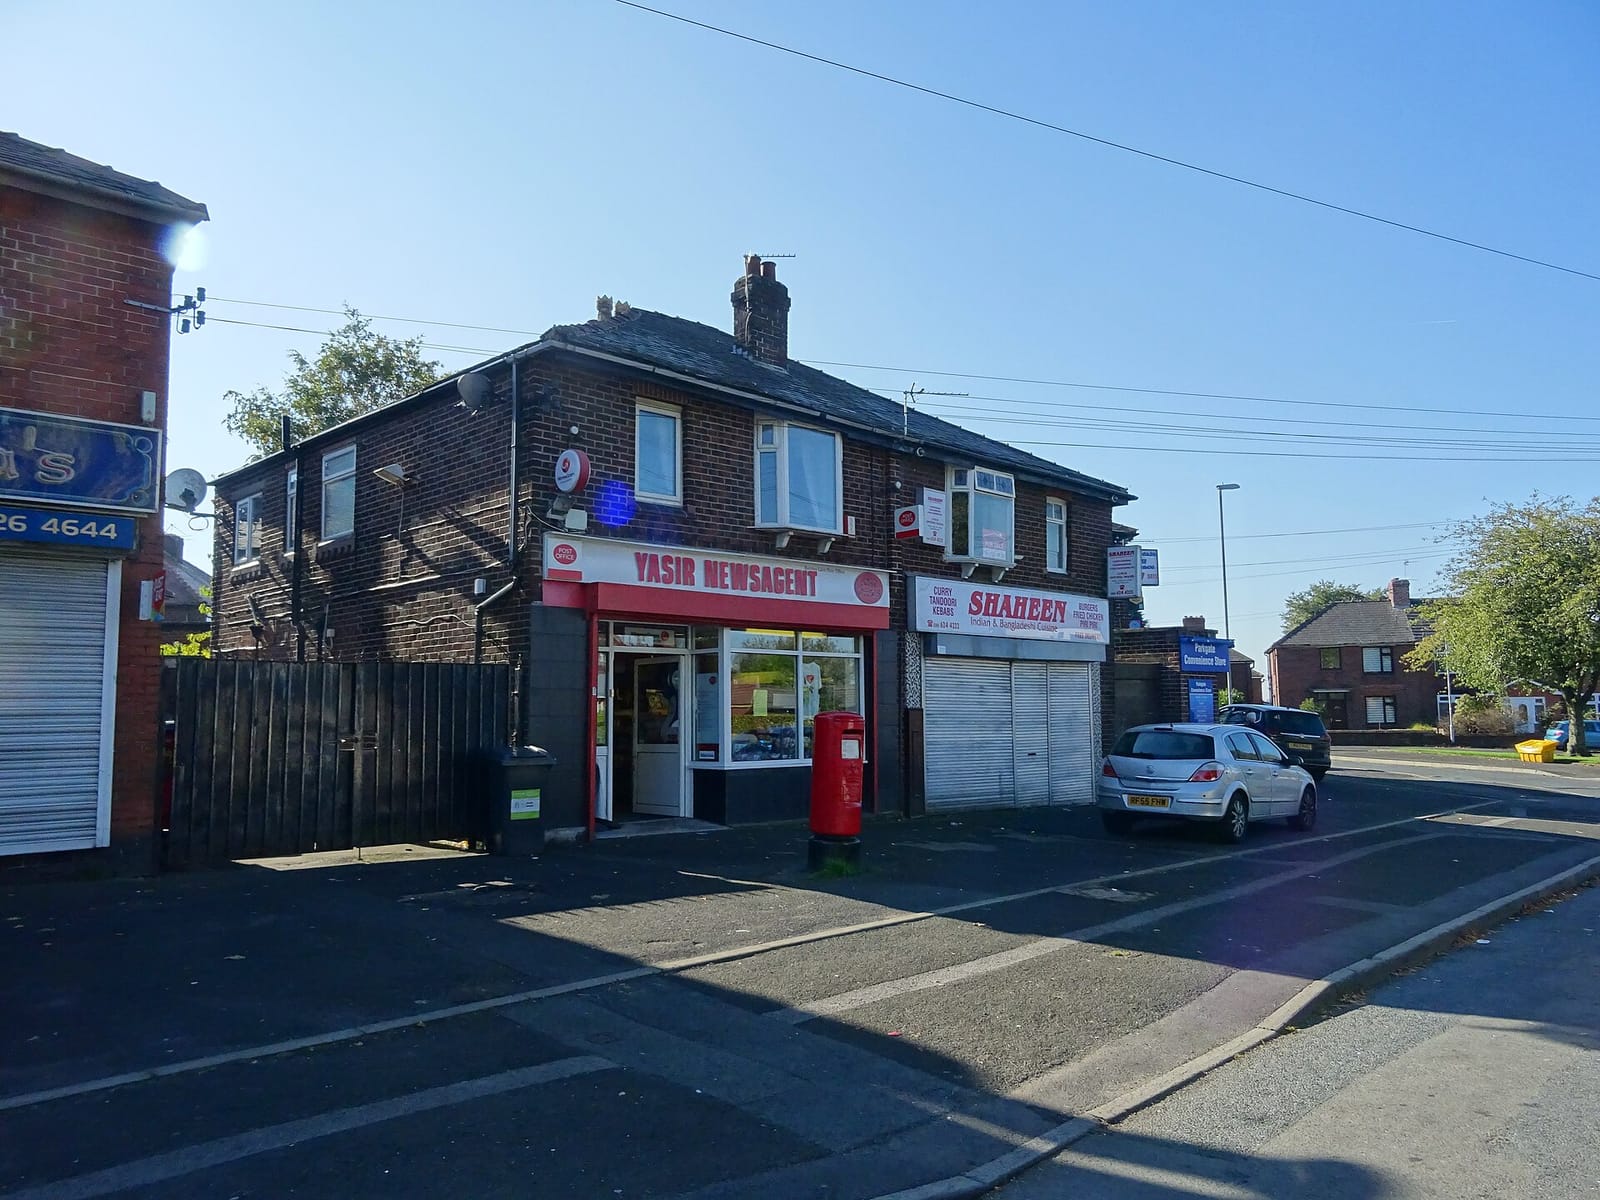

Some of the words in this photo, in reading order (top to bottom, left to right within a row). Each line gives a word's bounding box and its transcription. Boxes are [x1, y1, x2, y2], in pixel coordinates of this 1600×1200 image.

[40, 518, 118, 540] 4644
[555, 552, 575, 561] OFFICE
[635, 552, 696, 586] YASIR
[703, 560, 818, 597] NEWSAGENT
[933, 586, 953, 597] CURRY
[929, 595, 957, 607] TANDOORI
[968, 591, 1067, 623] SHAHEEN
[932, 606, 955, 617] KEBABS
[970, 616, 991, 628] Indian
[993, 618, 999, 628] &
[1000, 619, 1036, 632] Bangladeshi
[1037, 622, 1058, 632] Cuisine
[1194, 642, 1216, 655] Parkgate
[1184, 654, 1214, 666] Convenience
[1214, 656, 1227, 666] Store
